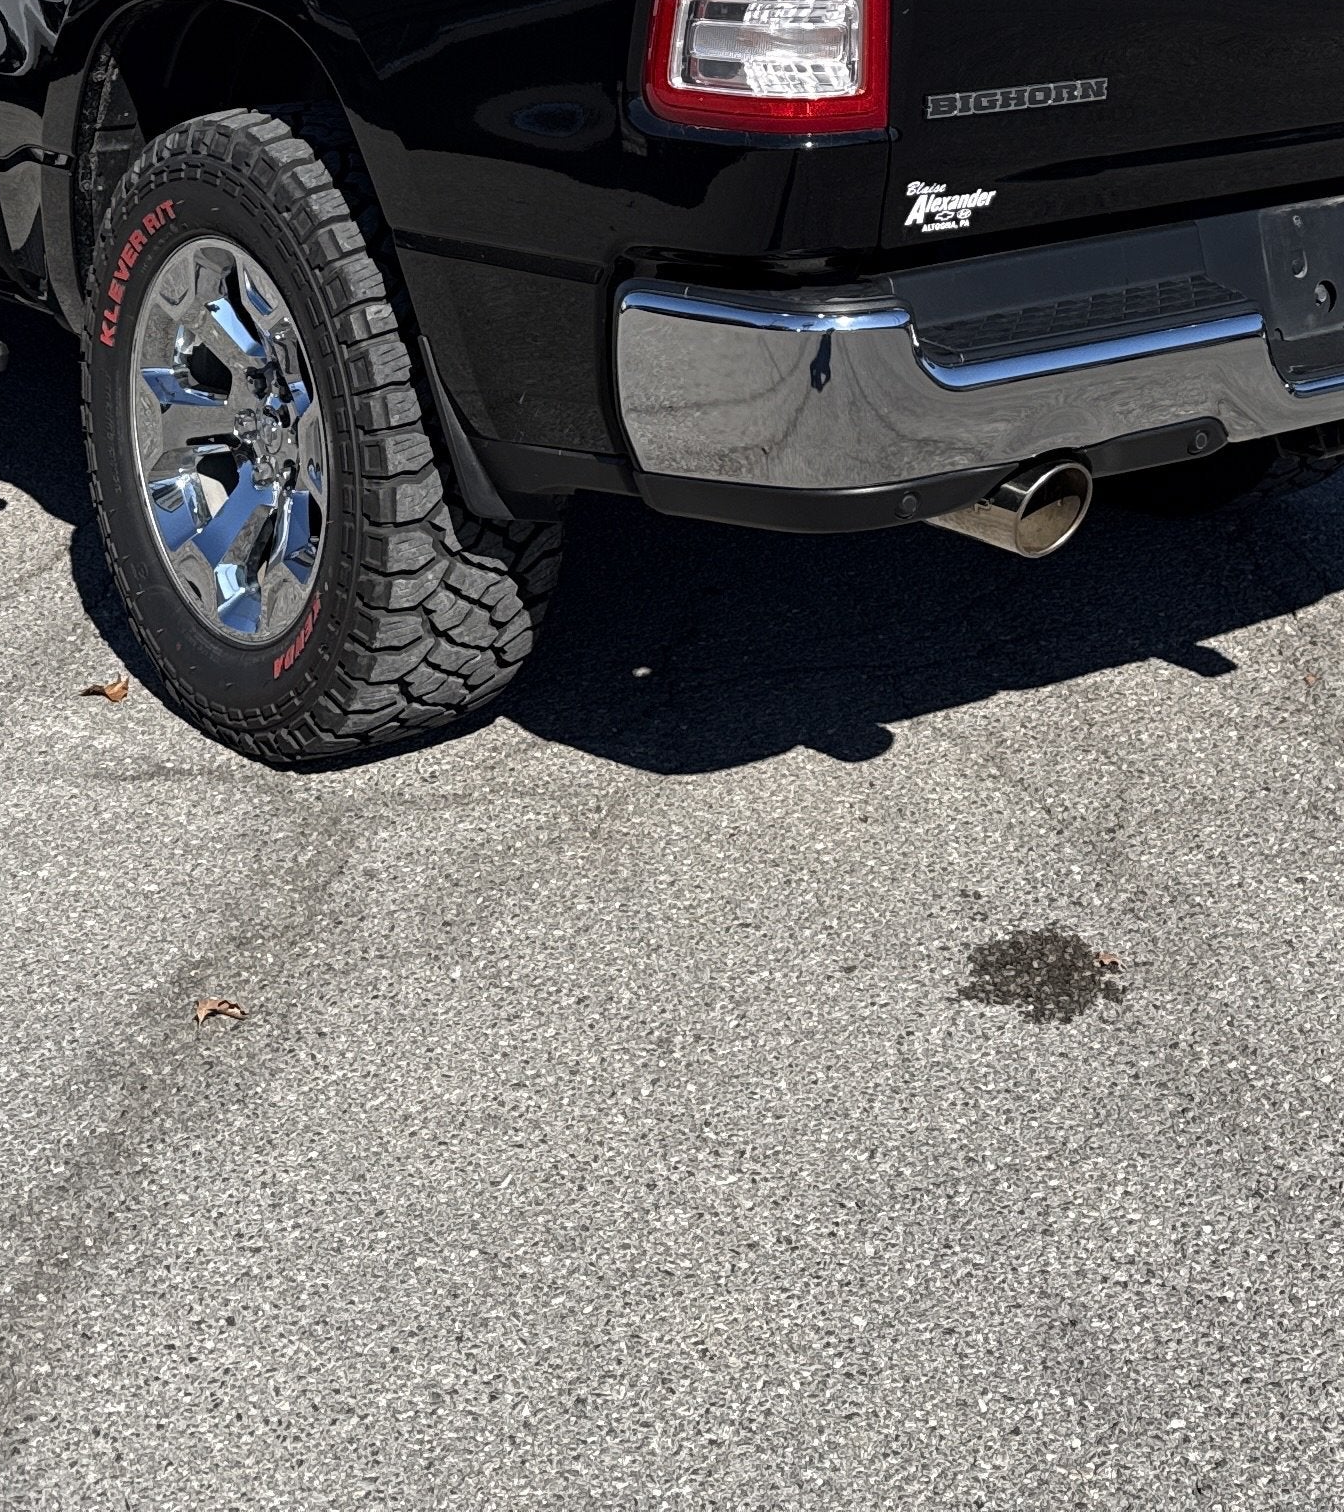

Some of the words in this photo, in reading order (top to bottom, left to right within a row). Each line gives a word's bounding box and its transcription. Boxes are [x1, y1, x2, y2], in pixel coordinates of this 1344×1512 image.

[926, 77, 1109, 120] BIGHORN
[904, 188, 997, 226] Alexander
[906, 180, 947, 196] Blaise
[99, 229, 149, 348] KLEVER
[141, 198, 177, 236] R/T
[273, 589, 322, 680] KENDA
